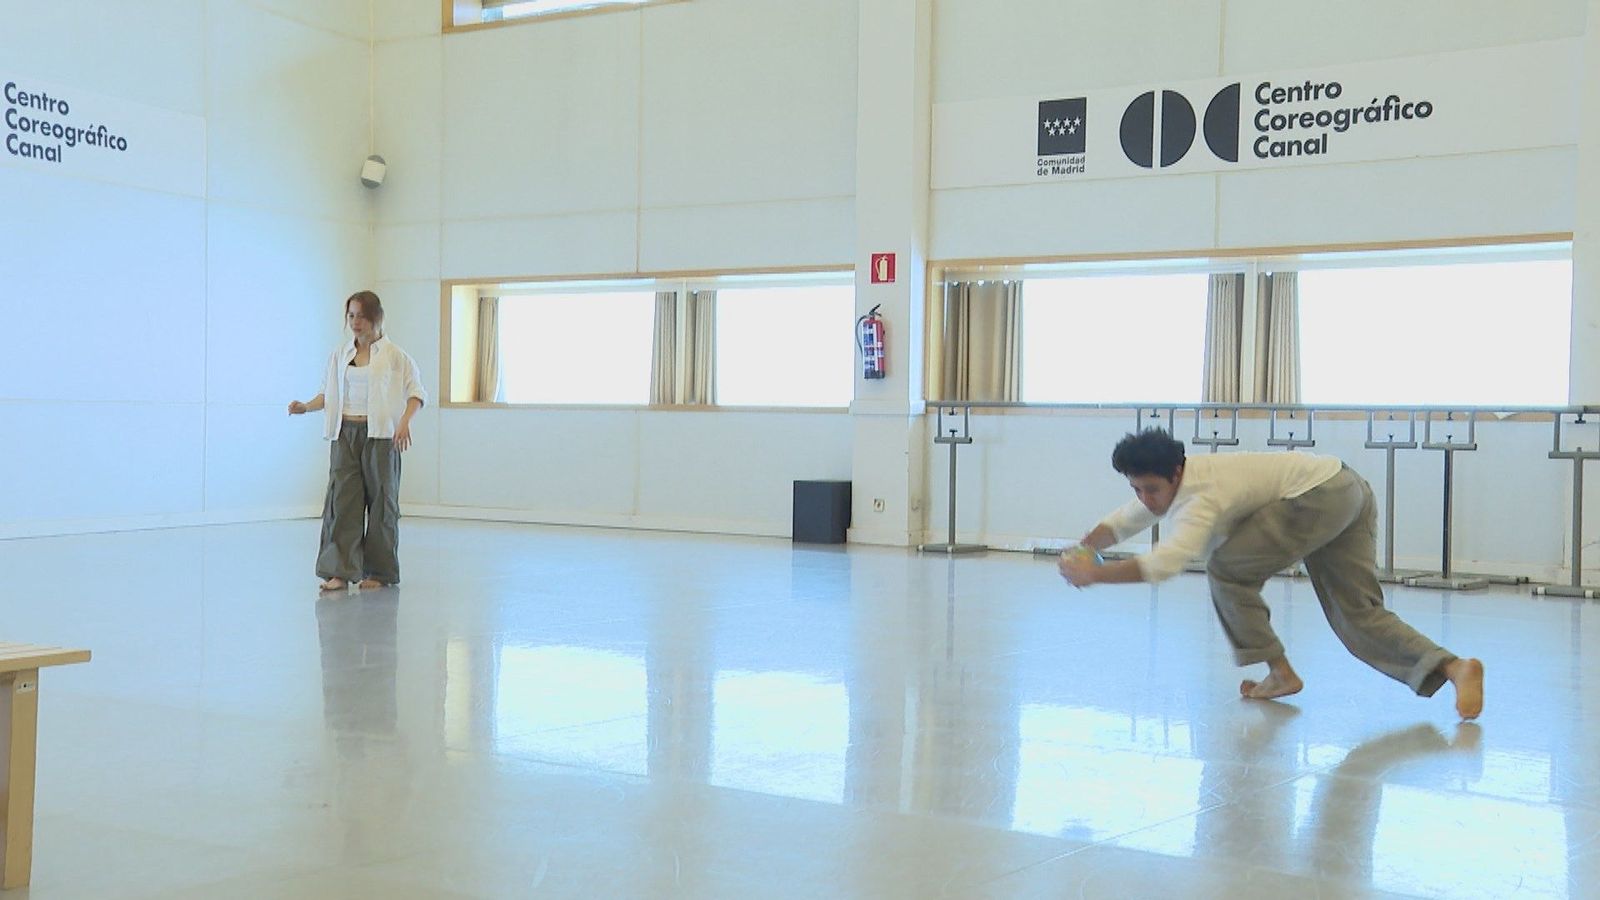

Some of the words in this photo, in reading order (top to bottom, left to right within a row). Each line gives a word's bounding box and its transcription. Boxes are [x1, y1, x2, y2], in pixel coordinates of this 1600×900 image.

[4, 81, 70, 116] Centro
[1254, 80, 1343, 106] Centro
[1253, 94, 1434, 133] Coreográfico
[5, 107, 128, 152] Coreográfico
[6, 133, 62, 163] Canal
[1252, 132, 1328, 160] Canal
[1036, 166, 1049, 176] de
[1051, 164, 1086, 175] Madrid
[1037, 156, 1086, 167] Comunidad
